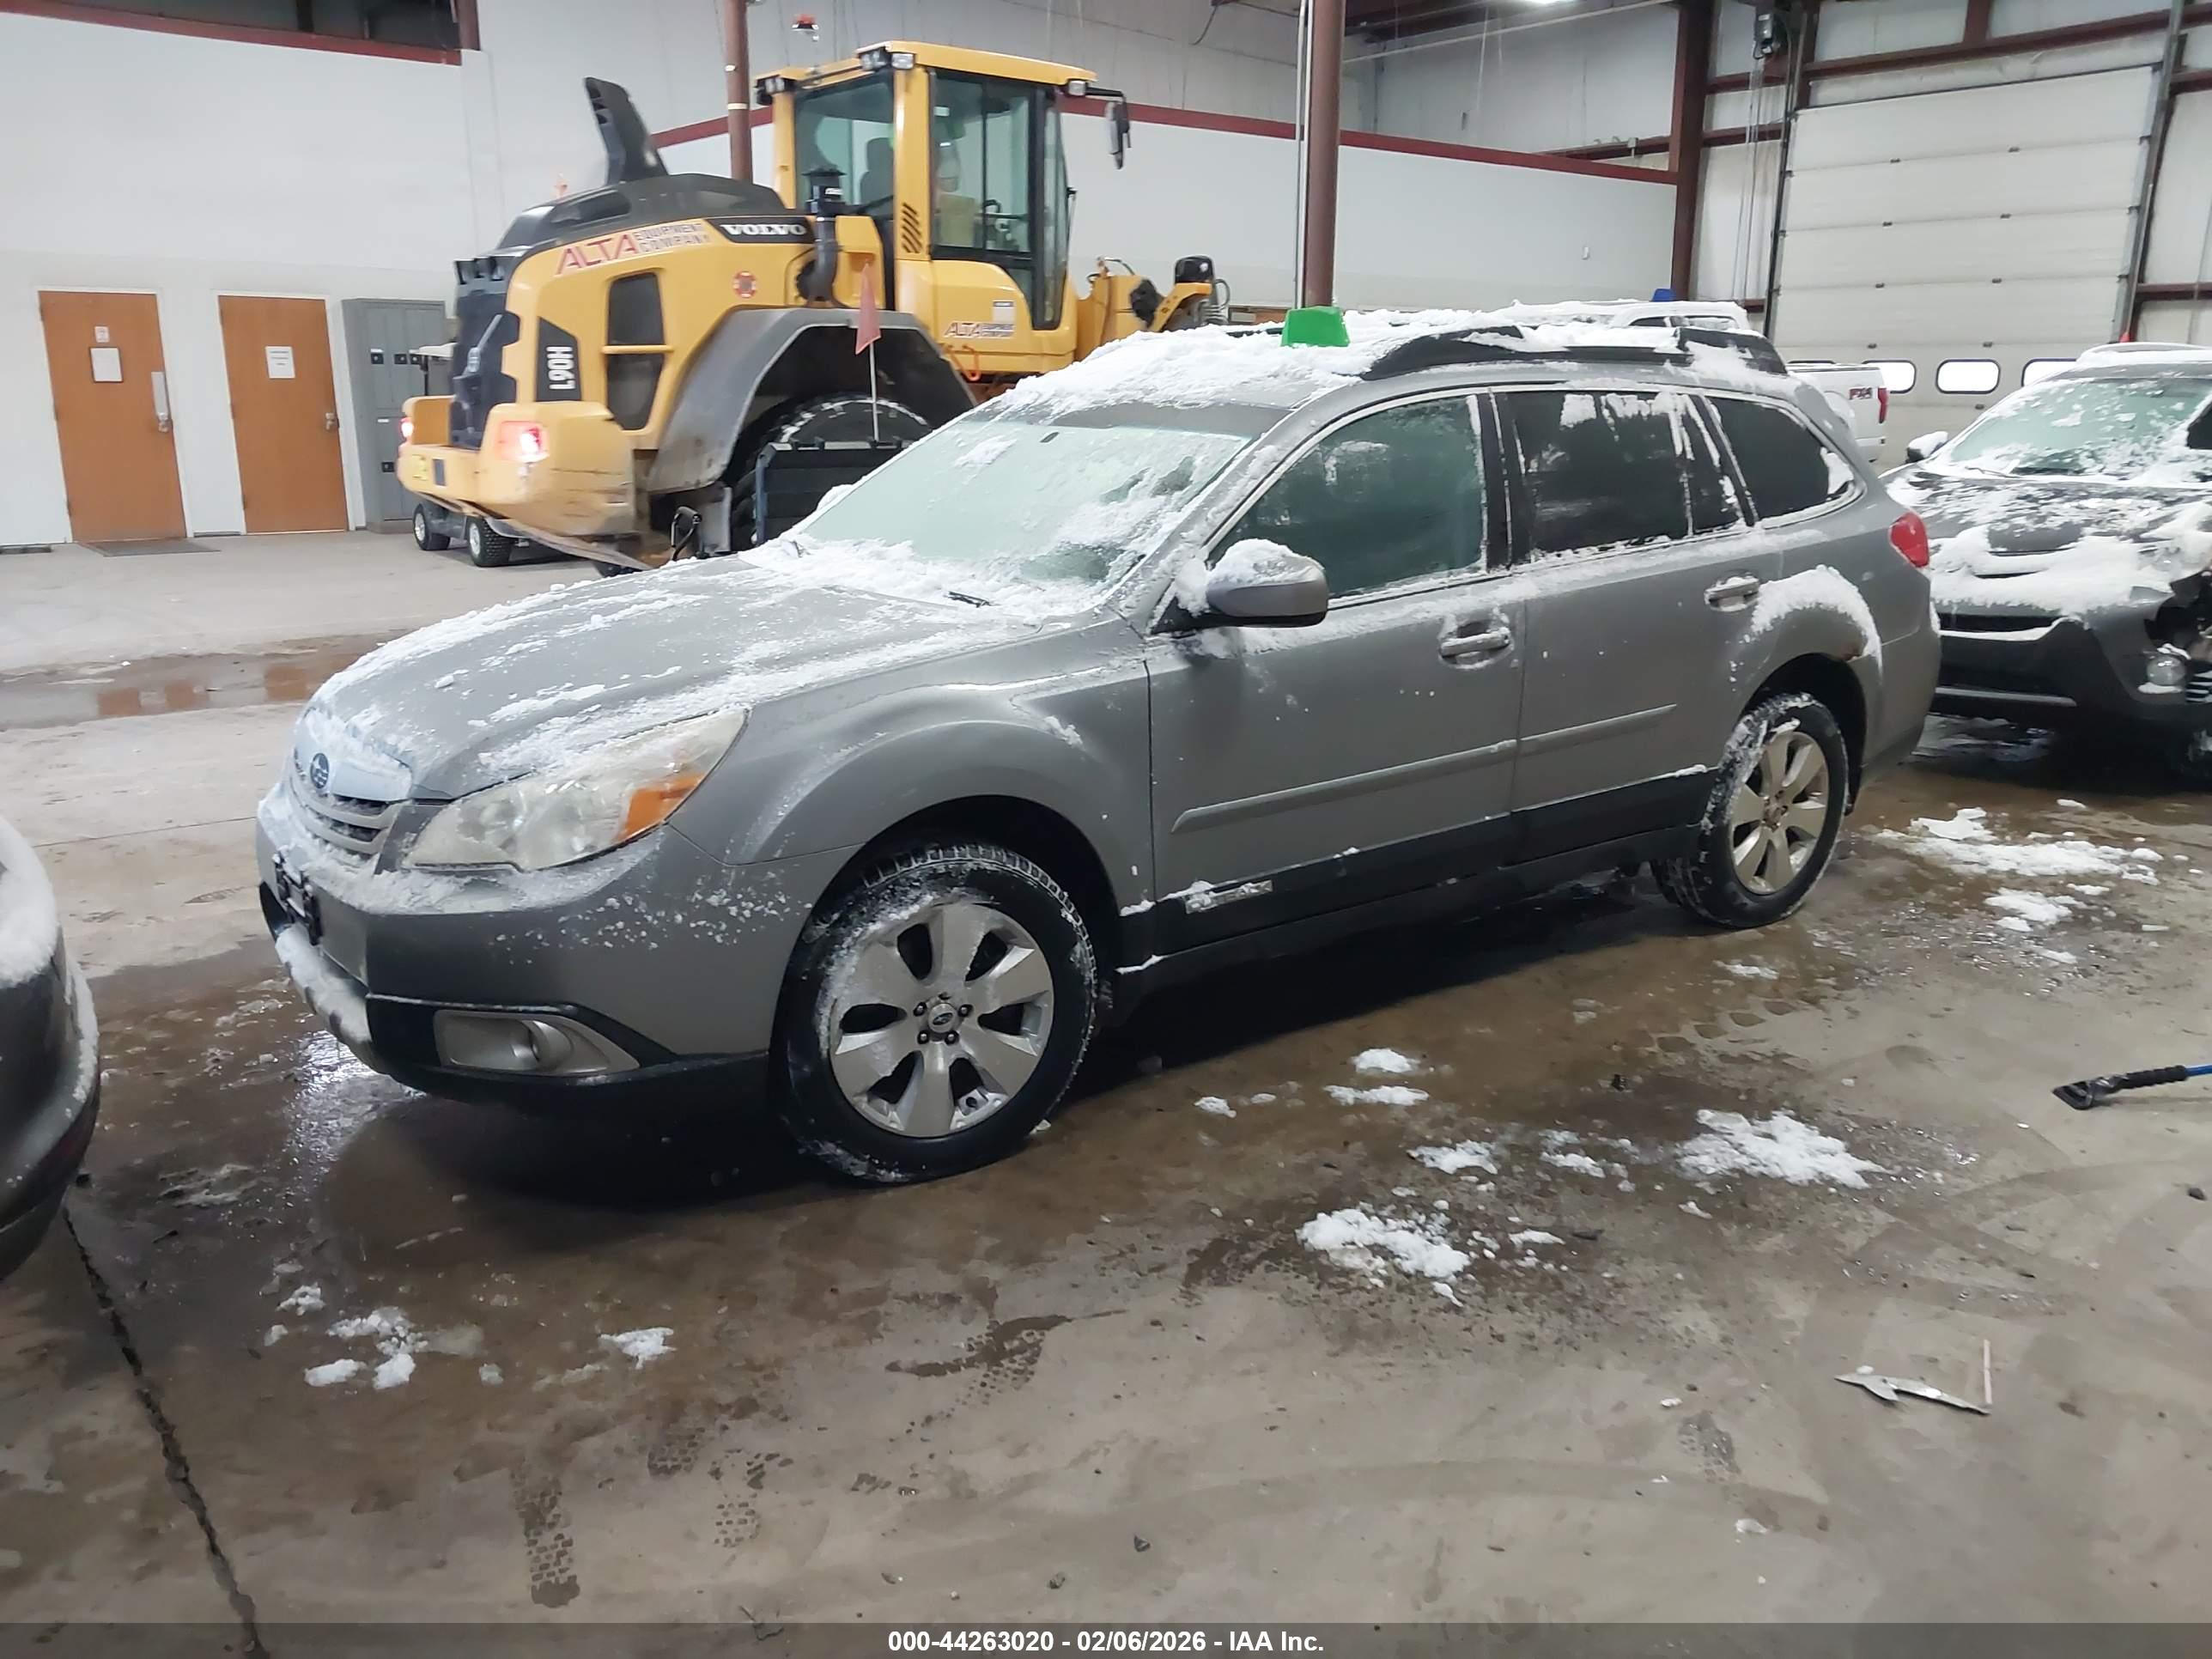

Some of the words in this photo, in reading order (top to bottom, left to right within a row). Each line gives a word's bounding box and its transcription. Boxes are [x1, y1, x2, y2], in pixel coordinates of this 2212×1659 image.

[720, 224, 806, 235] VOLVO
[554, 233, 638, 276] ALTA
[545, 346, 576, 390] L90H
